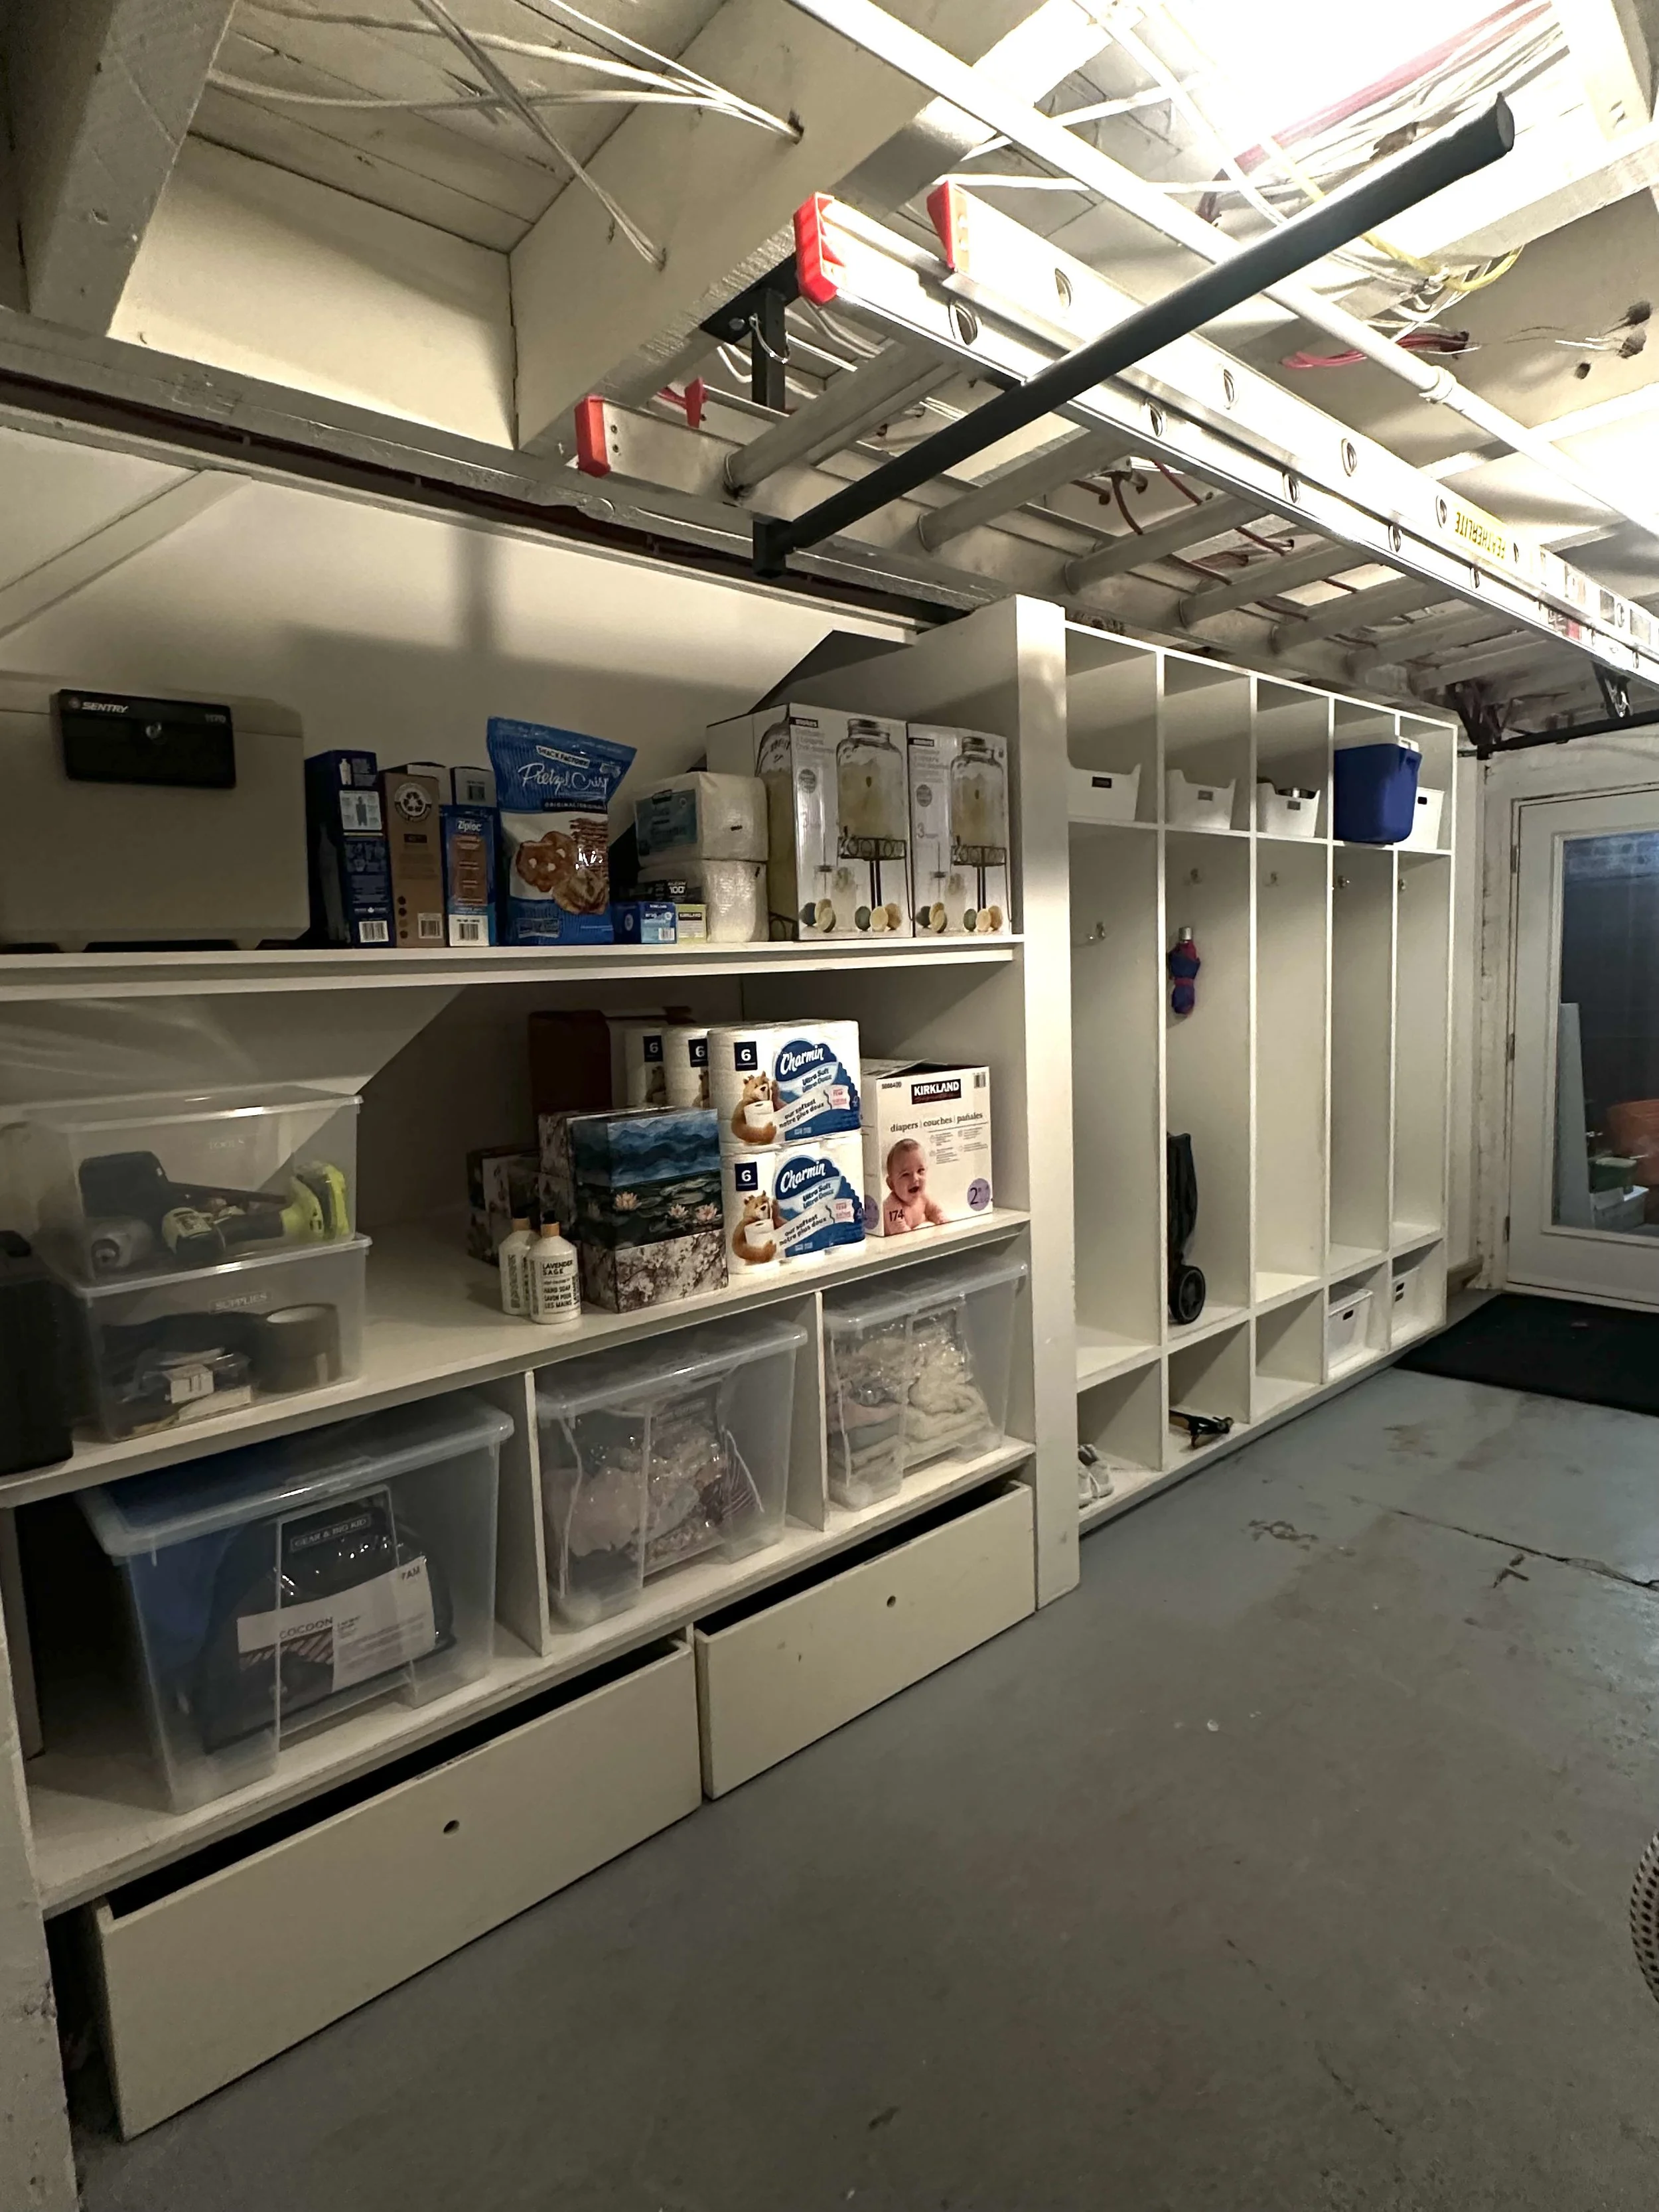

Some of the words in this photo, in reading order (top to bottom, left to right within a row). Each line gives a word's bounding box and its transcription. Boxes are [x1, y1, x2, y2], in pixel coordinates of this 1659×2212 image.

[1455, 512, 1506, 559] FEATHERLITE
[81, 701, 129, 713] SENTRY
[518, 762, 569, 796] Pretzel
[457, 819, 482, 832] Ziploc
[649, 1042, 659, 1053] 6
[695, 1045, 705, 1057] 6
[741, 1049, 751, 1061] 6
[780, 1045, 824, 1074] Charmin
[802, 1073, 817, 1085] Ultra
[818, 1068, 830, 1076] Soft
[914, 1081, 960, 1096] KIRKLAND
[779, 1118, 796, 1128] notre
[796, 1109, 809, 1121] plus
[810, 1102, 824, 1112] doux
[784, 1110, 794, 1120] our
[795, 1099, 816, 1113] softest
[890, 1120, 918, 1133] diapers
[923, 1117, 953, 1127] couches
[957, 1112, 983, 1124] pañales
[741, 1169, 751, 1181] 6
[780, 1160, 826, 1193] Charmin
[803, 1189, 818, 1202] Ultra
[818, 1183, 831, 1192] Soft
[970, 1187, 978, 1205] 2
[803, 1195, 818, 1209] Ultra
[889, 1209, 904, 1222] 174
[779, 1234, 797, 1246] notre
[797, 1224, 811, 1239] plus
[812, 1218, 827, 1230] doux
[784, 1226, 796, 1236] our
[796, 1214, 818, 1231] softest
[542, 1260, 573, 1269] LAVENDER
[214, 1293, 268, 1311] SUPPLIES
[294, 1532, 321, 1546] GEAR
[332, 1524, 349, 1534] BIG
[350, 1518, 367, 1528] KID
[279, 1616, 333, 1639] COCOON
